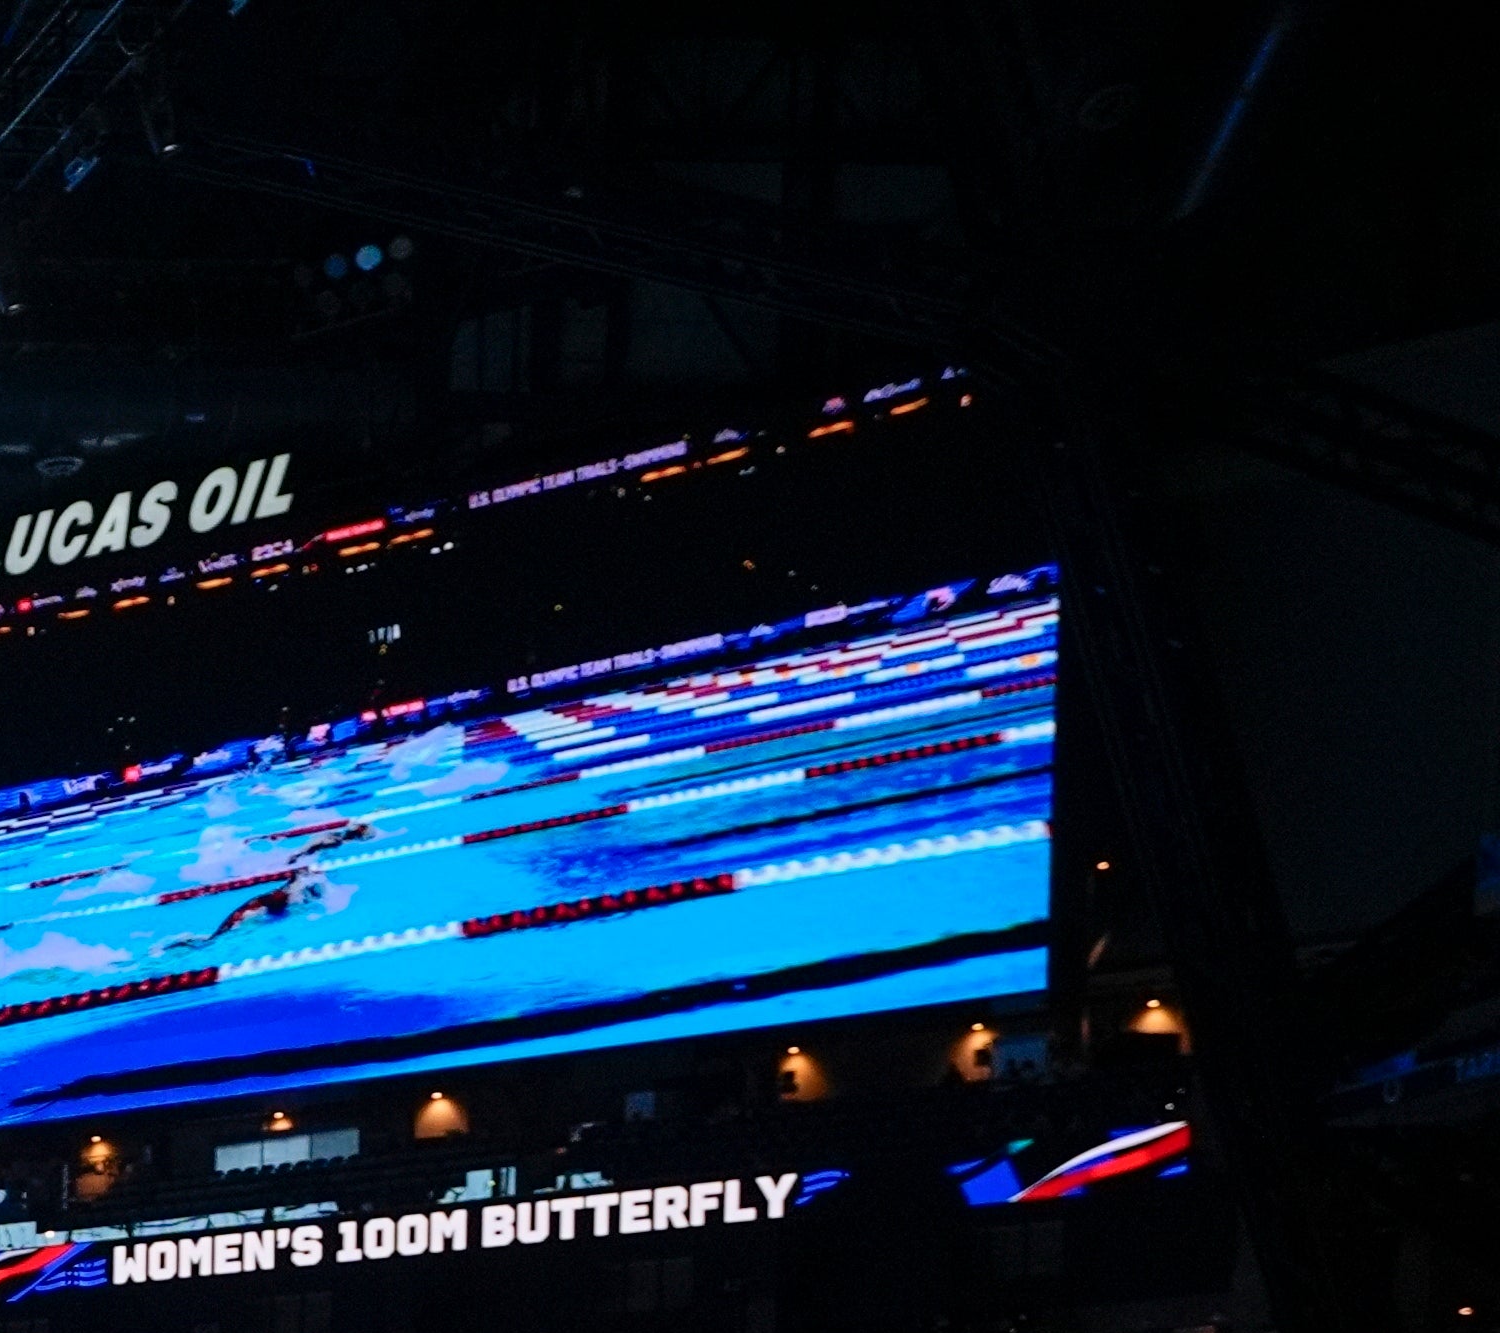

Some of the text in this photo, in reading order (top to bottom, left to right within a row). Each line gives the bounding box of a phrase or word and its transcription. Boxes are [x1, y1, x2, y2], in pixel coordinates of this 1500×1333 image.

[188, 451, 295, 535] OIL
[111, 1207, 468, 1286] WOMEN'S 100M
